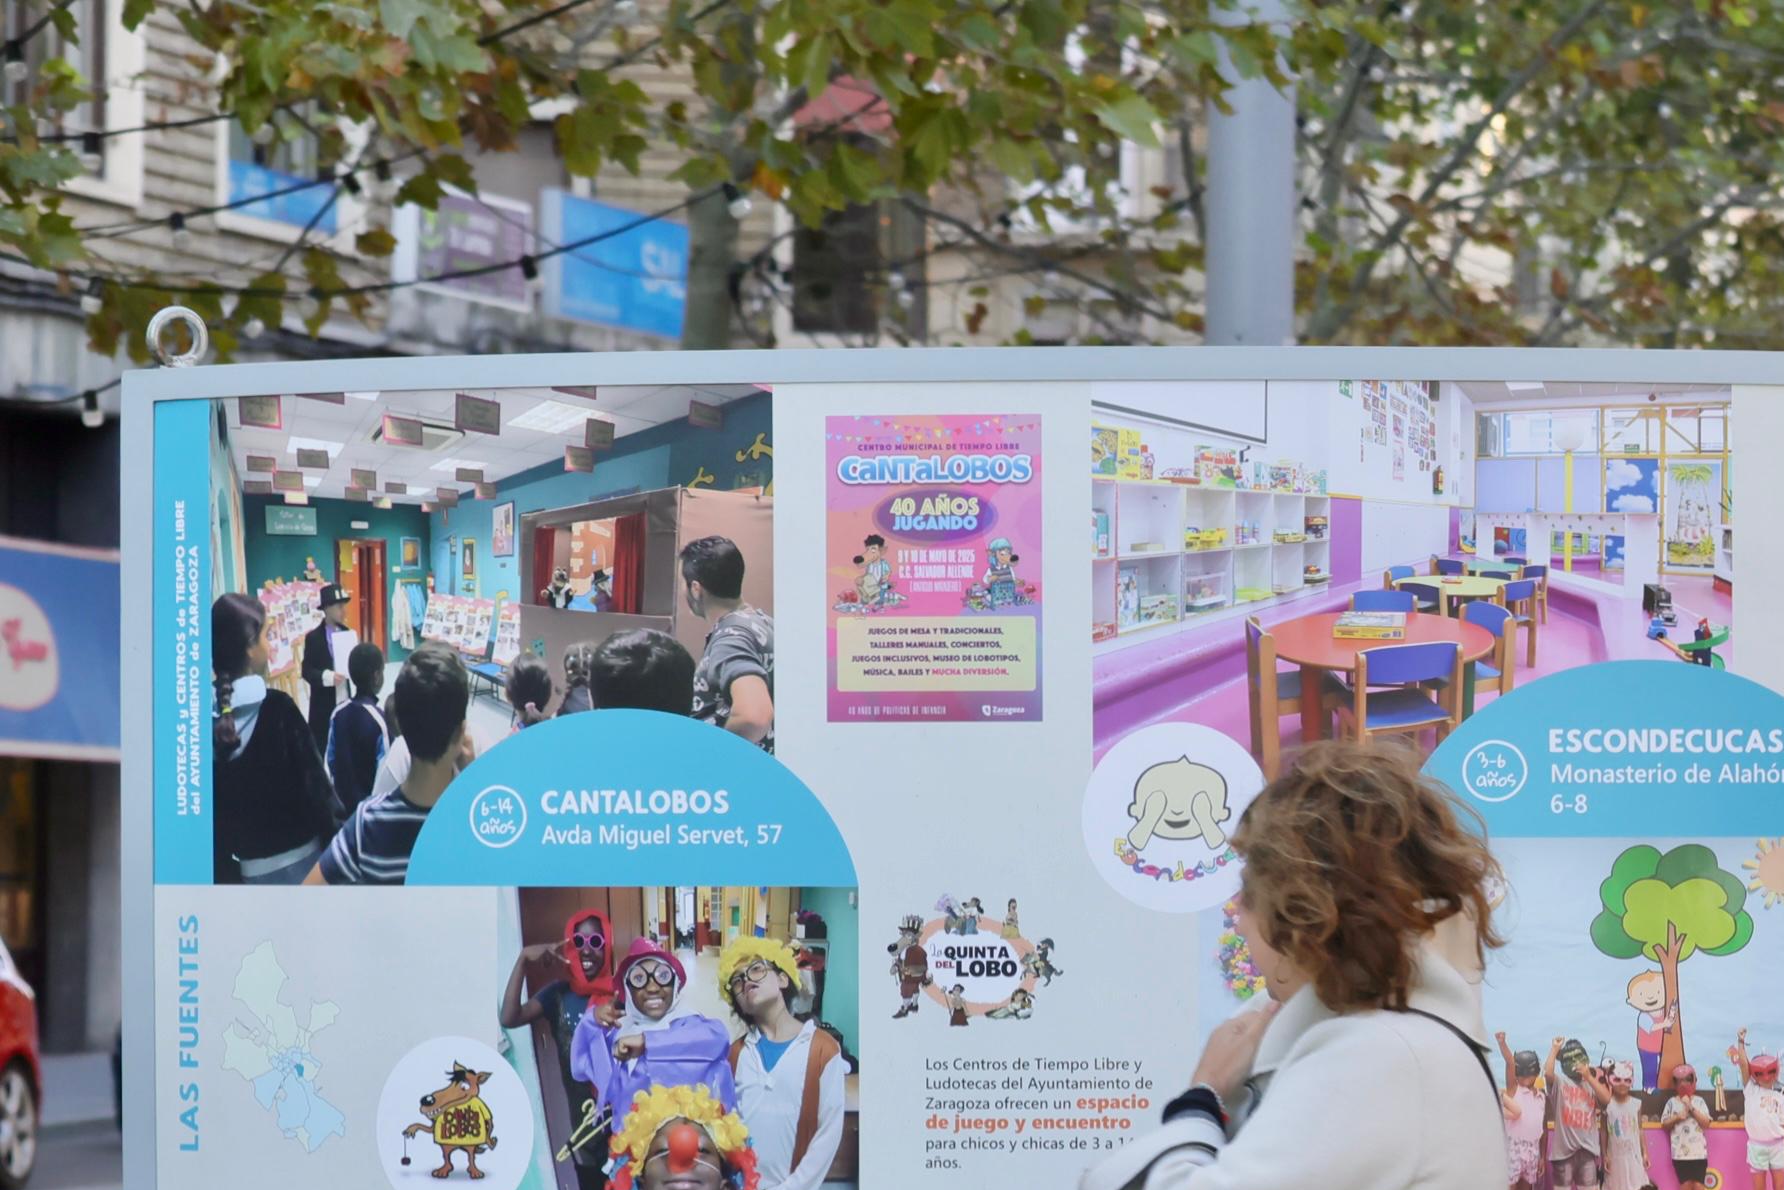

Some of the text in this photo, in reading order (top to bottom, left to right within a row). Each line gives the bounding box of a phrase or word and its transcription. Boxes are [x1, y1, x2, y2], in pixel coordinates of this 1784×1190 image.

[890, 494, 980, 515] 40 AÑOS
[174, 500, 185, 541] LIBRE
[892, 515, 978, 531] JUGANDO
[176, 545, 186, 604] TIEMPO
[178, 609, 186, 628] de
[176, 632, 186, 705] CENTROS
[188, 545, 200, 815] del AYUNTAMIENTO de ZARAGOZA
[1548, 728, 1784, 753] ESCONDECUCAS
[177, 723, 187, 815] LUDOTECAS
[1476, 751, 1506, 769] 3-6
[1475, 771, 1517, 788] años
[1551, 762, 1677, 784] Monasterio
[1684, 762, 1711, 784] de
[480, 797, 513, 816] 6-14
[540, 790, 730, 814] CANTALOBOS
[1550, 794, 1588, 814] 6-8
[479, 818, 516, 835] años
[542, 824, 783, 850] Avda Miguel Servet, 57
[944, 946, 1010, 960] QUINTA
[935, 960, 1018, 977] DEL LOBO
[179, 914, 199, 1152] LAS FUENTES
[925, 1057, 1143, 1074] Los Centros de Tiempo Libre y
[925, 1077, 1154, 1093] Ludotecas del Ayuntamiento de
[925, 1094, 1150, 1114] Zaragoza ofrecen un espacio
[925, 1114, 1132, 1134] de juego y encuentro
[925, 1136, 1113, 1153] para chicos y chicas de 3 a
[925, 1156, 962, 1170] años.
